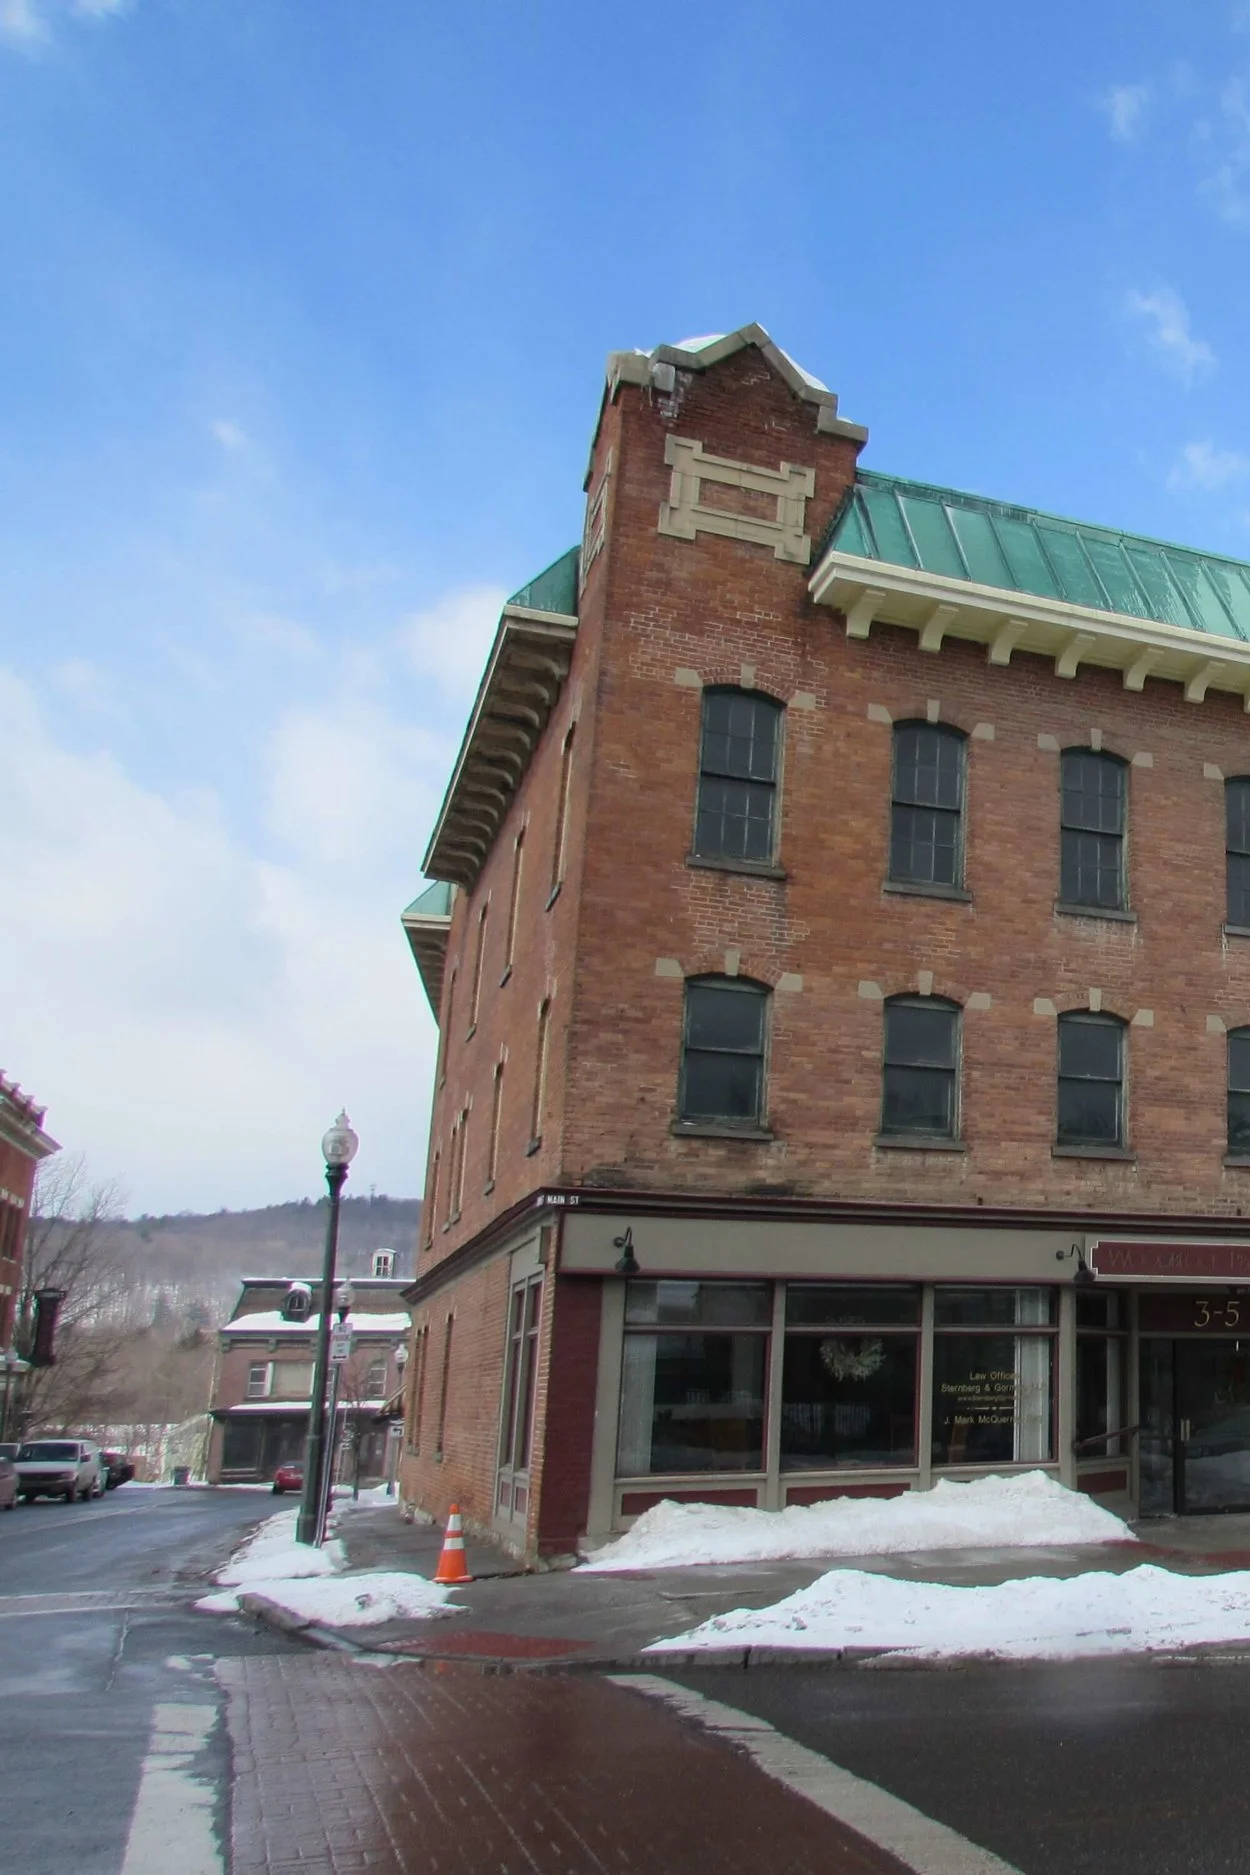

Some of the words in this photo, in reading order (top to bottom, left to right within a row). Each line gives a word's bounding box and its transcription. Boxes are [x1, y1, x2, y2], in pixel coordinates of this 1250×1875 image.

[547, 1195, 565, 1205] MAIN
[570, 1195, 579, 1205] ST
[1194, 1301, 1240, 1327] 3-5
[970, 1372, 986, 1380] Law
[941, 1383, 980, 1393] Sternberg
[984, 1383, 990, 1392] &
[955, 1415, 975, 1424] Mark
